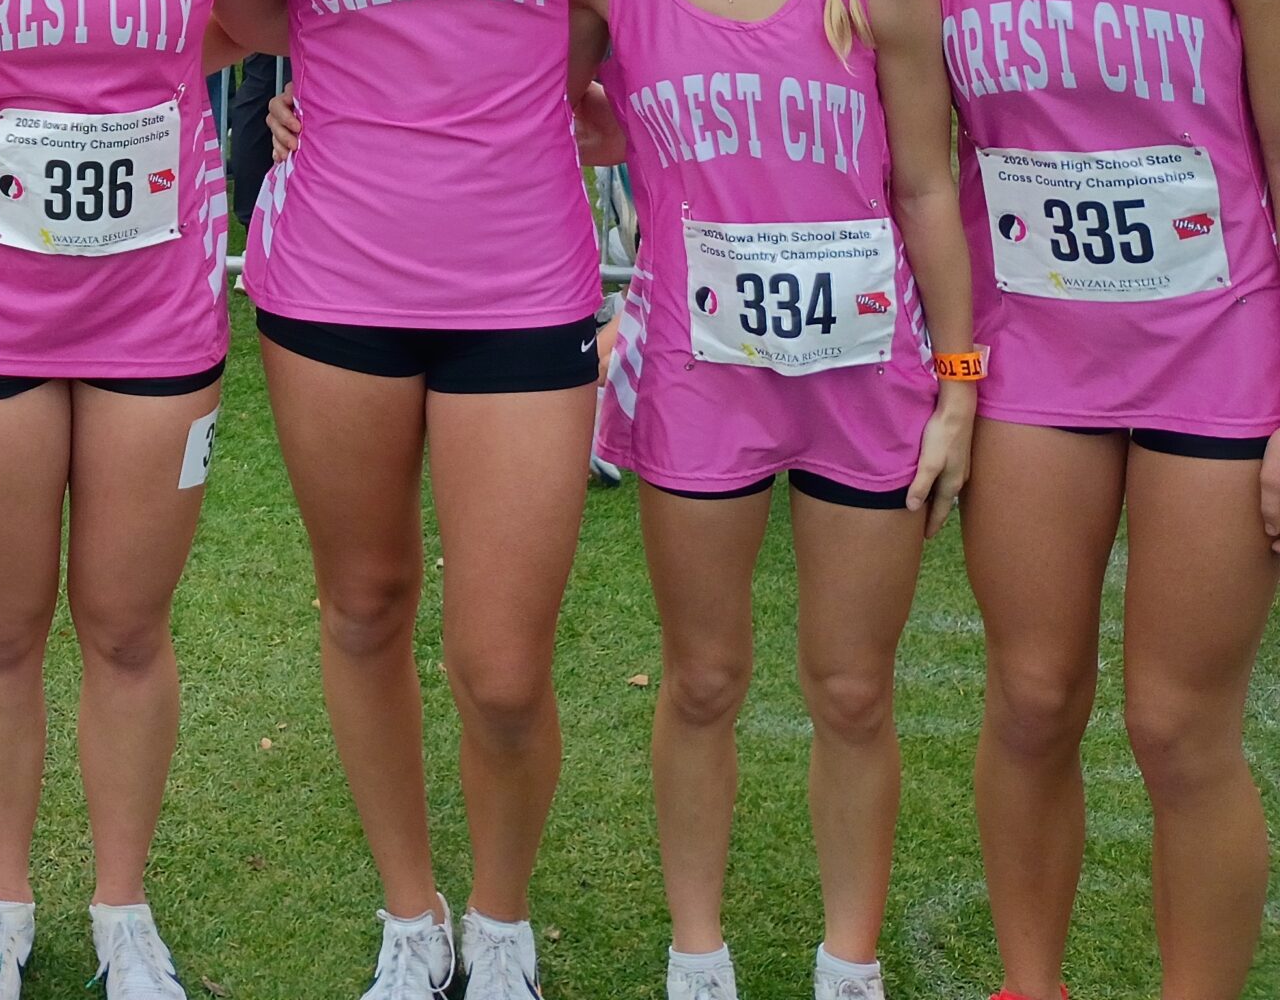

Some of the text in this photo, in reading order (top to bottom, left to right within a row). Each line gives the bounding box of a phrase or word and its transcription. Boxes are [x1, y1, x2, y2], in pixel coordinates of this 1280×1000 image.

[942, 0, 1206, 105] OREST CITY
[15, 114, 165, 134] 2026 Iowa High School State
[779, 76, 866, 177] CITY
[6, 129, 170, 151] Cross Country Championships
[1002, 153, 1182, 172] 2026 Iowa High School State
[998, 169, 1195, 190] Cross Country Championships
[44, 158, 134, 222] 336
[52, 234, 99, 244] WAYZATA
[102, 228, 138, 243] RESULTS
[725, 233, 753, 243] Iowa
[757, 232, 787, 244] High
[791, 231, 835, 241] School
[839, 230, 870, 240] State
[1043, 199, 1154, 265] 335
[700, 243, 878, 263] Cross Country Championships
[1062, 275, 1170, 288] WAYZATA RESULTS
[736, 272, 837, 339] 334
[802, 347, 842, 361] RESULTS
